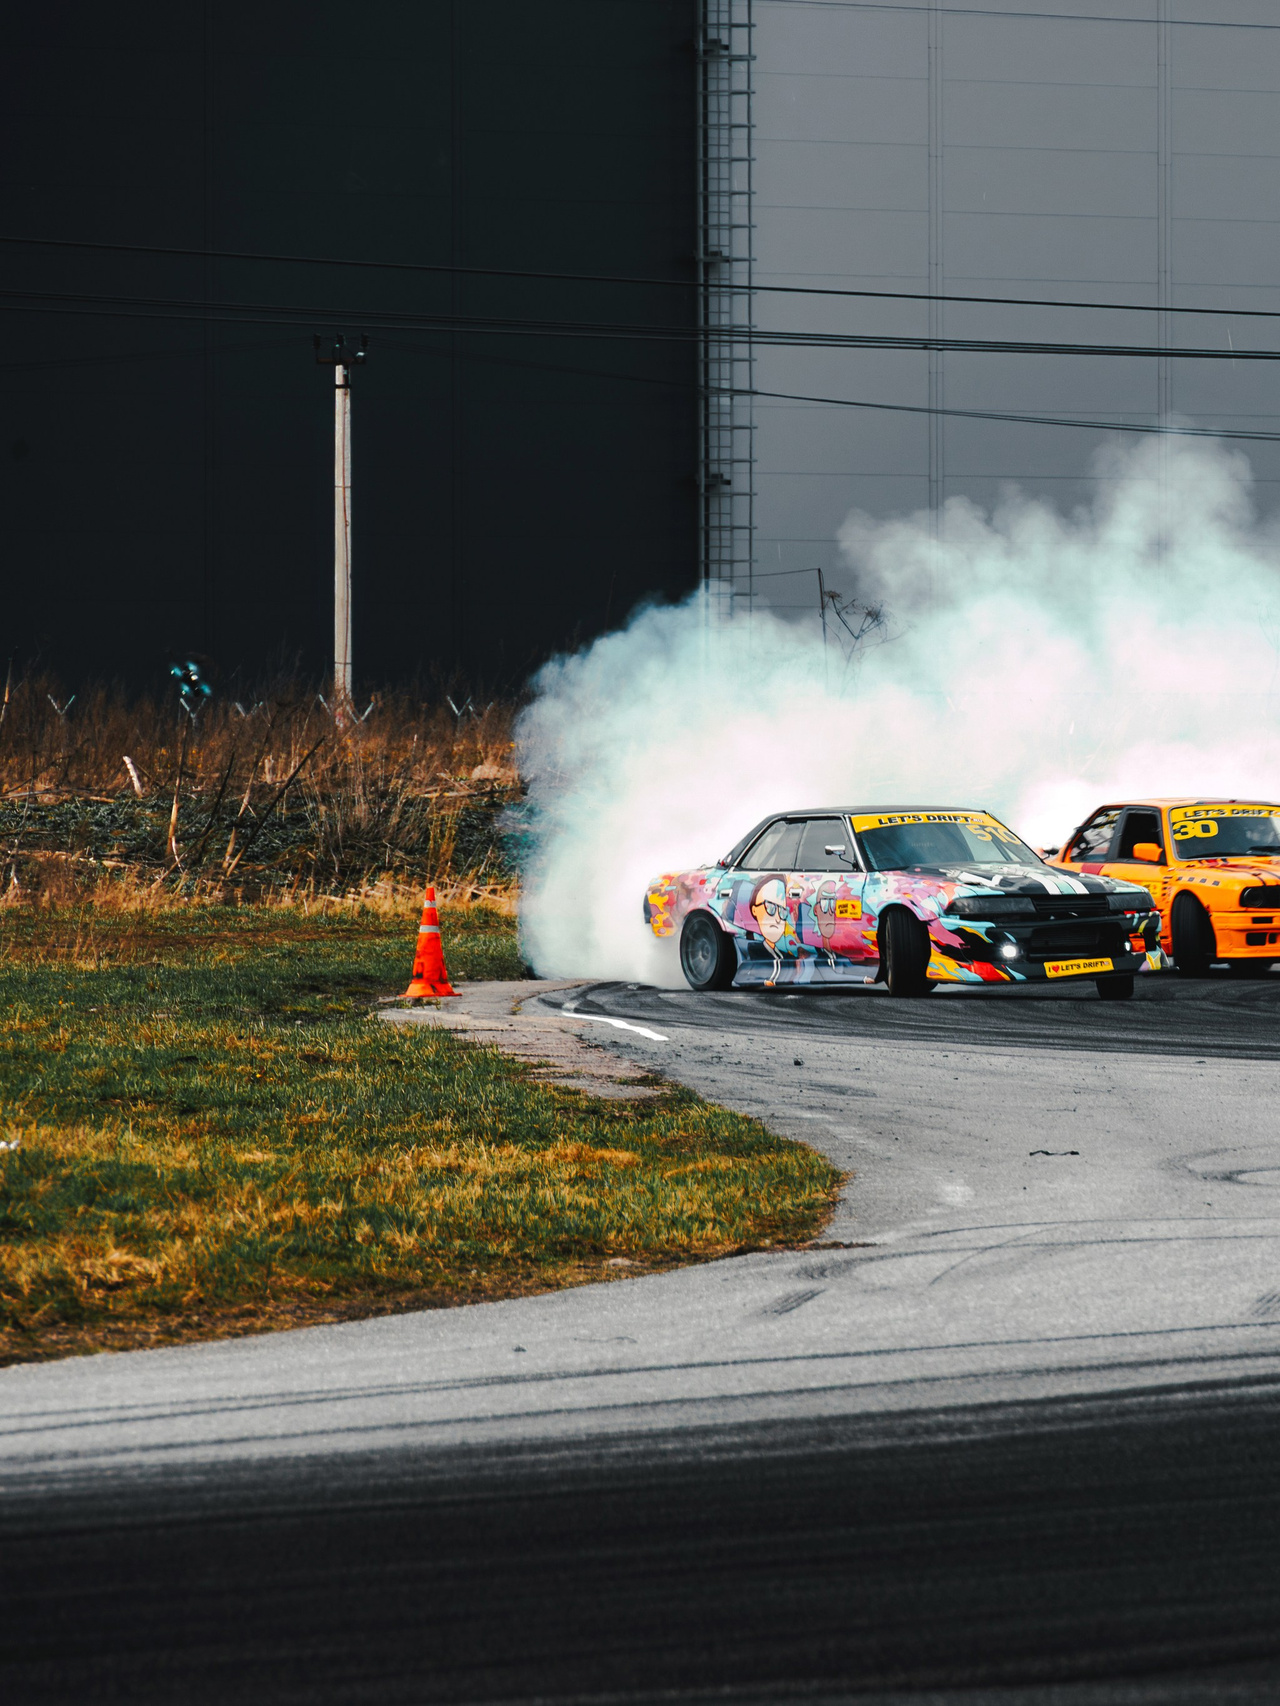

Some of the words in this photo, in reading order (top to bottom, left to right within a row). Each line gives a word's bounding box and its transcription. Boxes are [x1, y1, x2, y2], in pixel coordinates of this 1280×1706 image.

[1184, 809, 1228, 818] LET'S
[878, 815, 923, 825] LET'S
[965, 824, 1022, 845] 510
[1172, 819, 1219, 841] 30
[1061, 963, 1081, 971] LET'S
